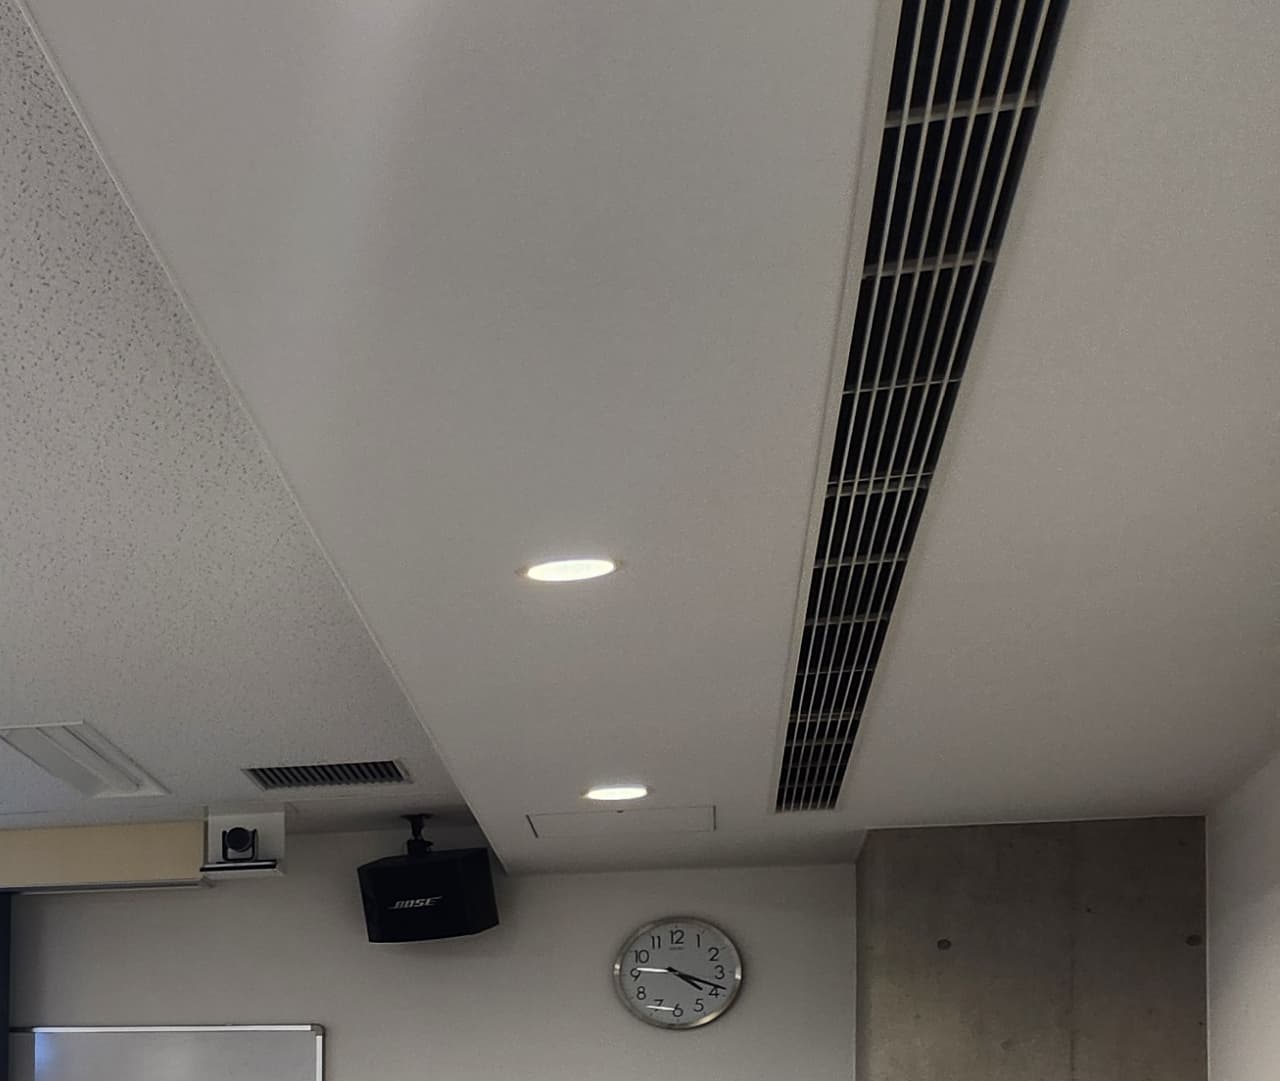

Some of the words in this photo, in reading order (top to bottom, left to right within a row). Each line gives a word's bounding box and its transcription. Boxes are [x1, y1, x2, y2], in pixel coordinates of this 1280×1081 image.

[651, 935, 661, 949] 11
[670, 929, 685, 945] 12
[696, 933, 701, 948] 1
[634, 949, 649, 964] 10
[707, 947, 719, 961] 2
[630, 968, 641, 981] 9
[714, 965, 725, 980] 3
[636, 986, 646, 1000] 8
[708, 986, 720, 998] 4
[672, 1003, 684, 1017] 6
[693, 998, 704, 1012] 5
